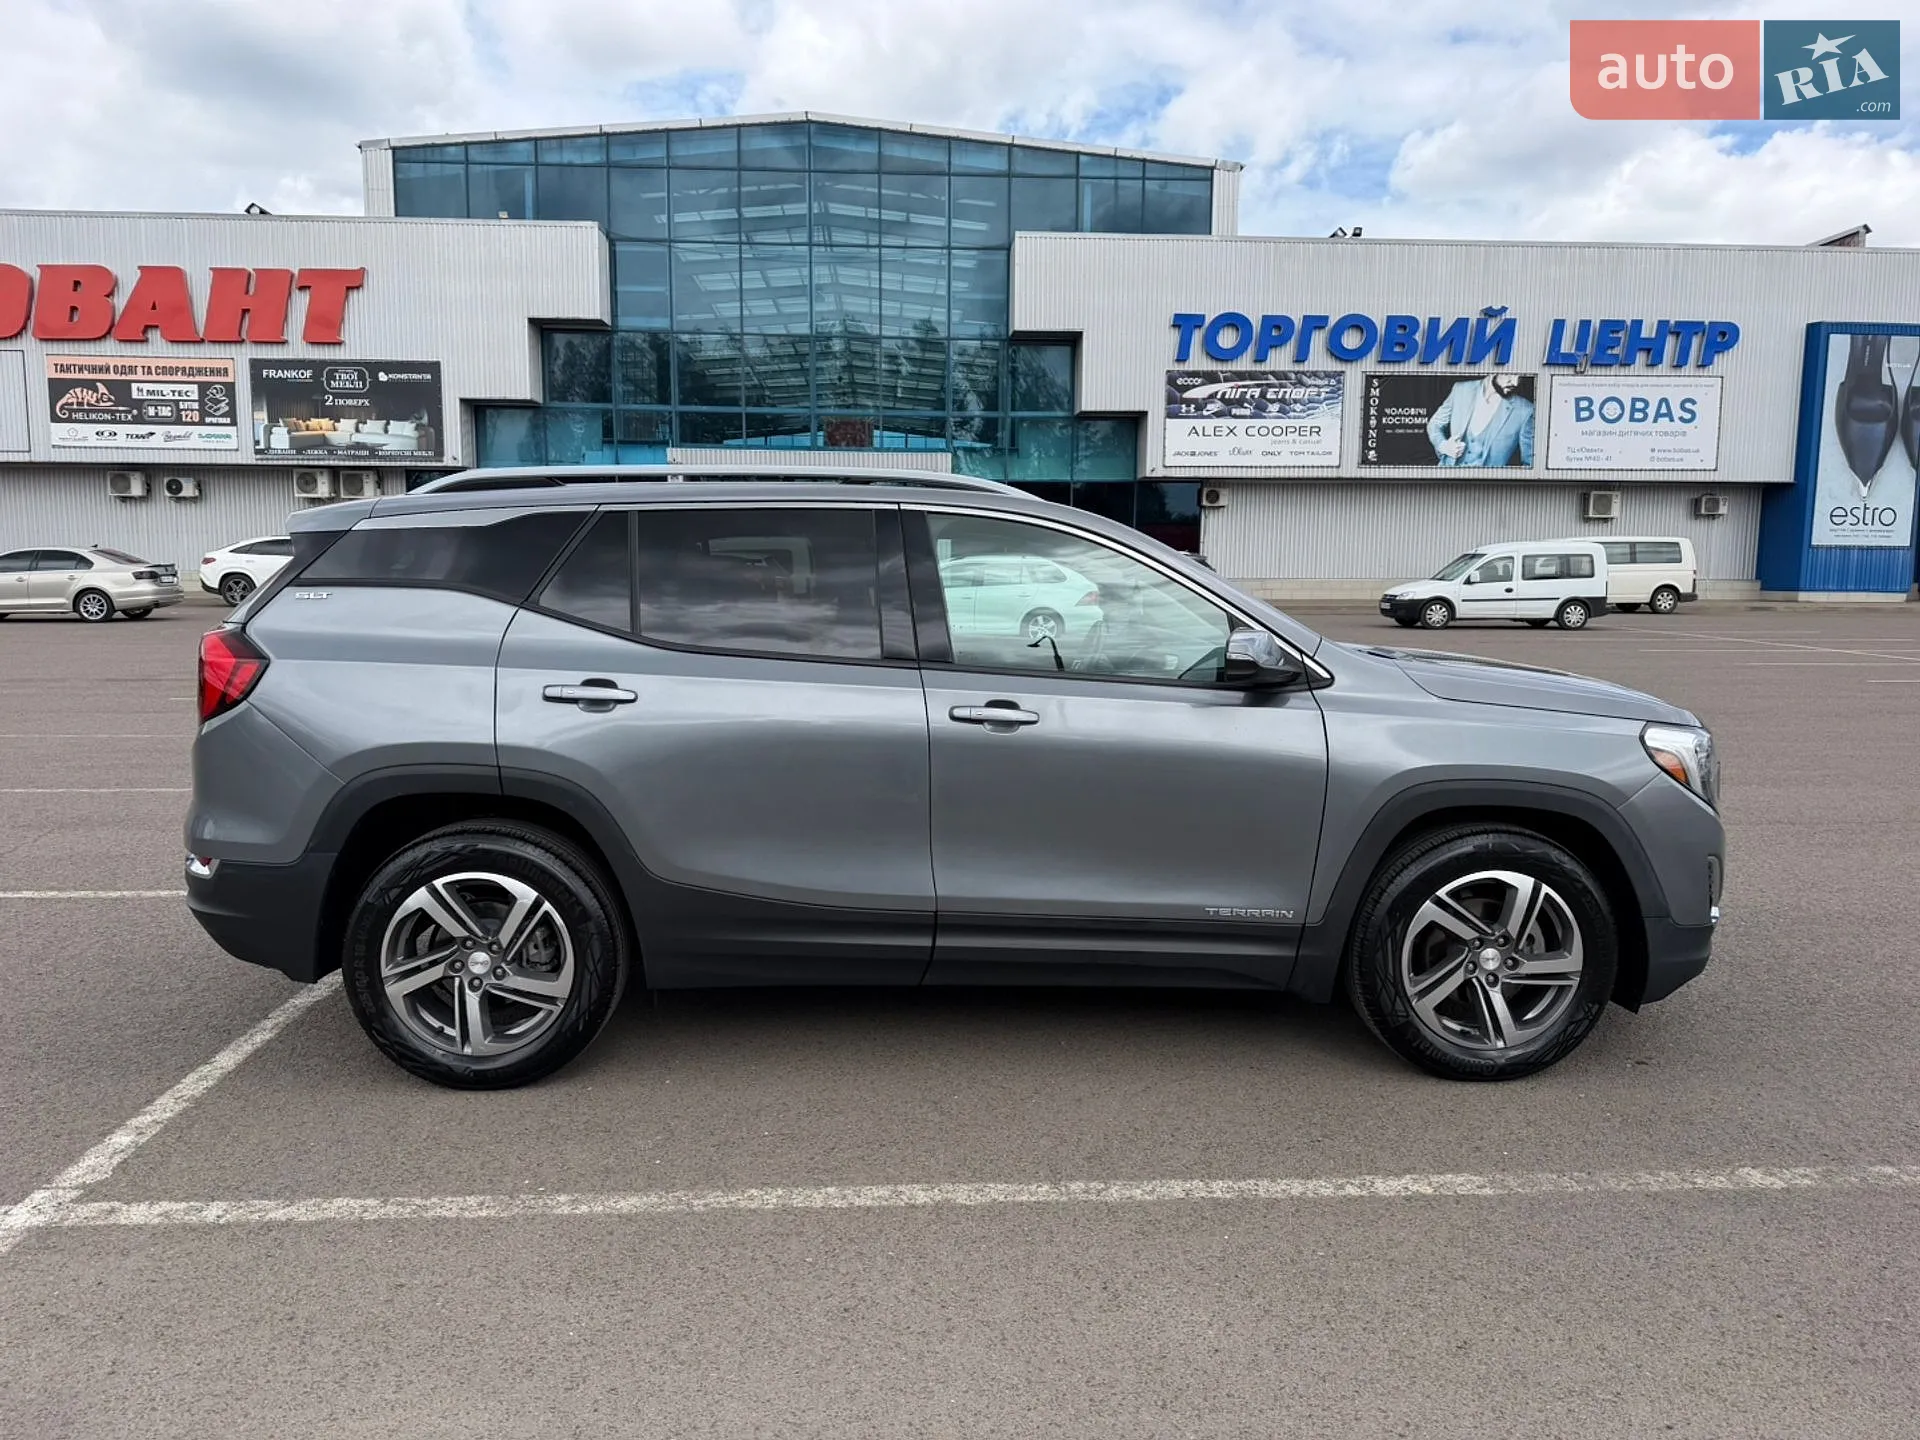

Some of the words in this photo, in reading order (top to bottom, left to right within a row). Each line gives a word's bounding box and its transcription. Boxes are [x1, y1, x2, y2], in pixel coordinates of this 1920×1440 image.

[1171, 305, 1517, 365] ТОРГОВИЙ
[1543, 318, 1741, 371] ЦЕНТР
[53, 362, 111, 375] ТАКТИЧНИЙ
[112, 364, 140, 377] ОДЯГ
[141, 364, 154, 376] ТА
[155, 365, 229, 378] СПОРЯДЖЕННЯ
[262, 369, 313, 379] FRANKOF
[324, 394, 333, 405] 2
[334, 398, 371, 407] ПОВЕРХ
[1384, 407, 1427, 415] ЧОЛОВІЧІ
[1574, 396, 1698, 424] BOBAS
[72, 412, 132, 421] HELIKON-TEX
[181, 411, 200, 422] 120
[1382, 416, 1428, 424] КОСТЮМИ
[1187, 426, 1237, 437] ALEX
[1245, 425, 1322, 437] COOPER
[1829, 503, 1897, 526] estro
[1204, 907, 1294, 919] TERRAIN
